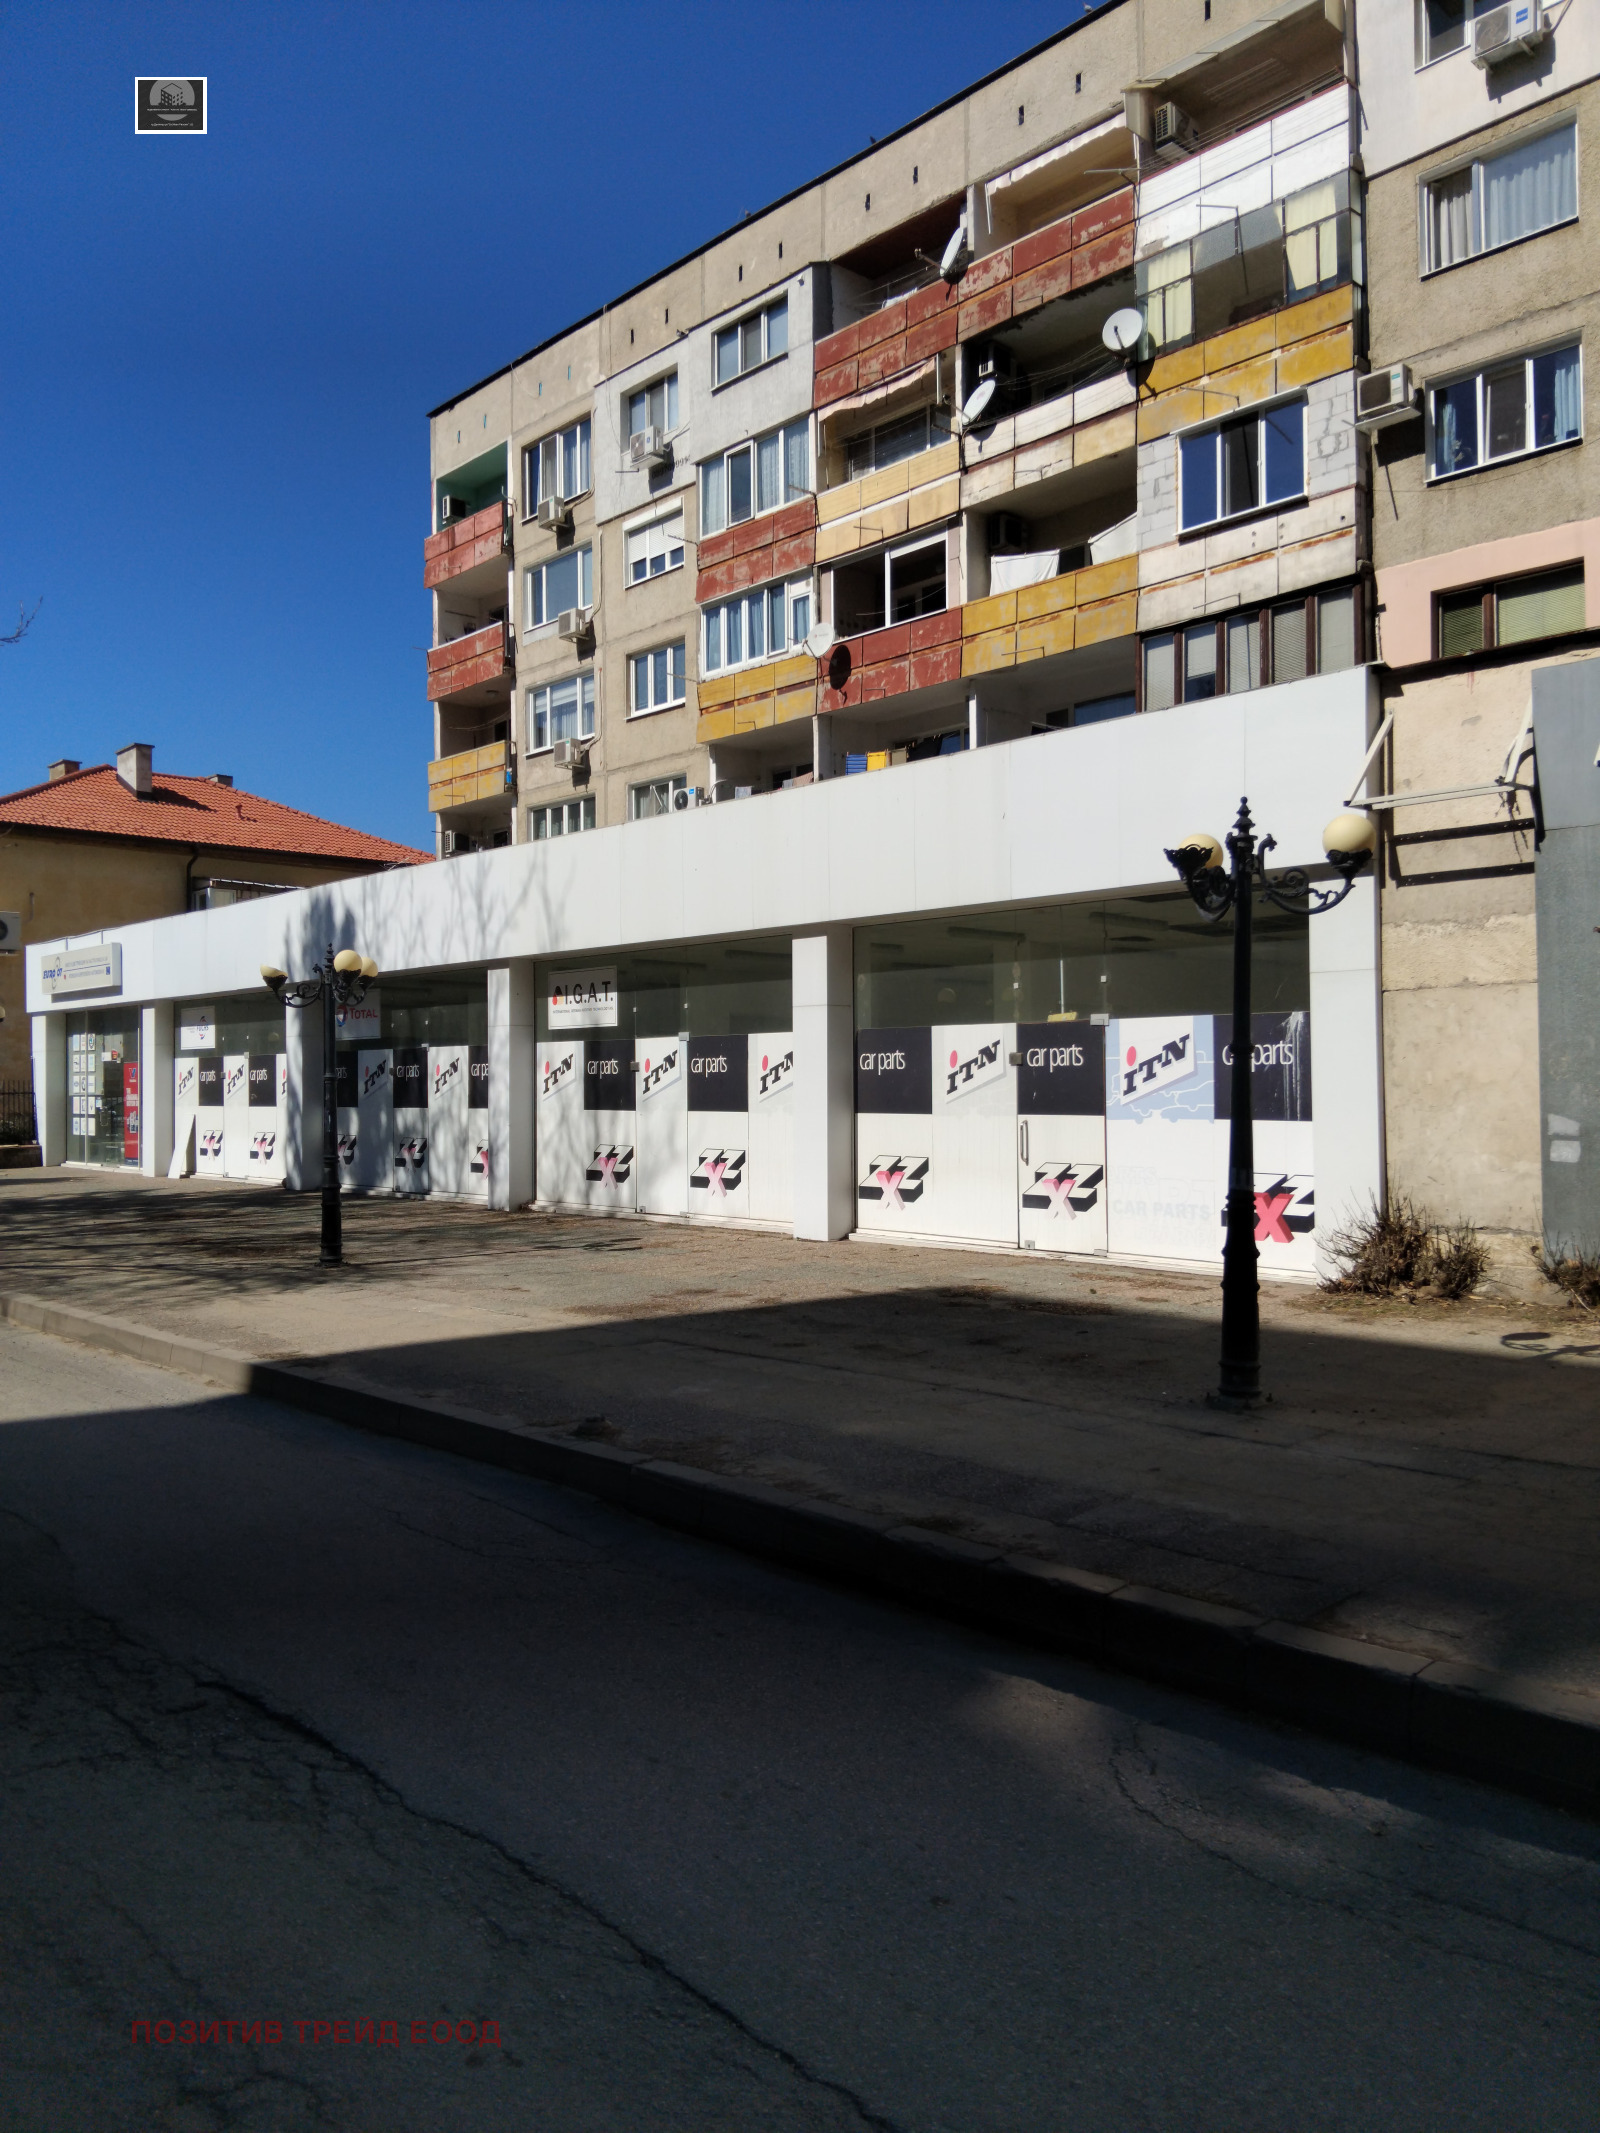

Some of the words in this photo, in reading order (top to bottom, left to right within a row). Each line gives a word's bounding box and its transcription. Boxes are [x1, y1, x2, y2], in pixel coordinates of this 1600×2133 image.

[565, 981, 613, 1004] I.G.A.T.
[588, 1060, 599, 1075] car
[600, 1058, 619, 1079] parts
[691, 1057, 704, 1073] car
[706, 1055, 728, 1077] parts
[860, 1052, 876, 1070] car
[878, 1050, 905, 1075] parts
[1027, 1048, 1047, 1067] car
[1050, 1044, 1083, 1073] parts
[336, 1067, 348, 1079] arts
[397, 1066, 406, 1077] car
[406, 1064, 420, 1081] parts
[471, 1064, 481, 1077] car
